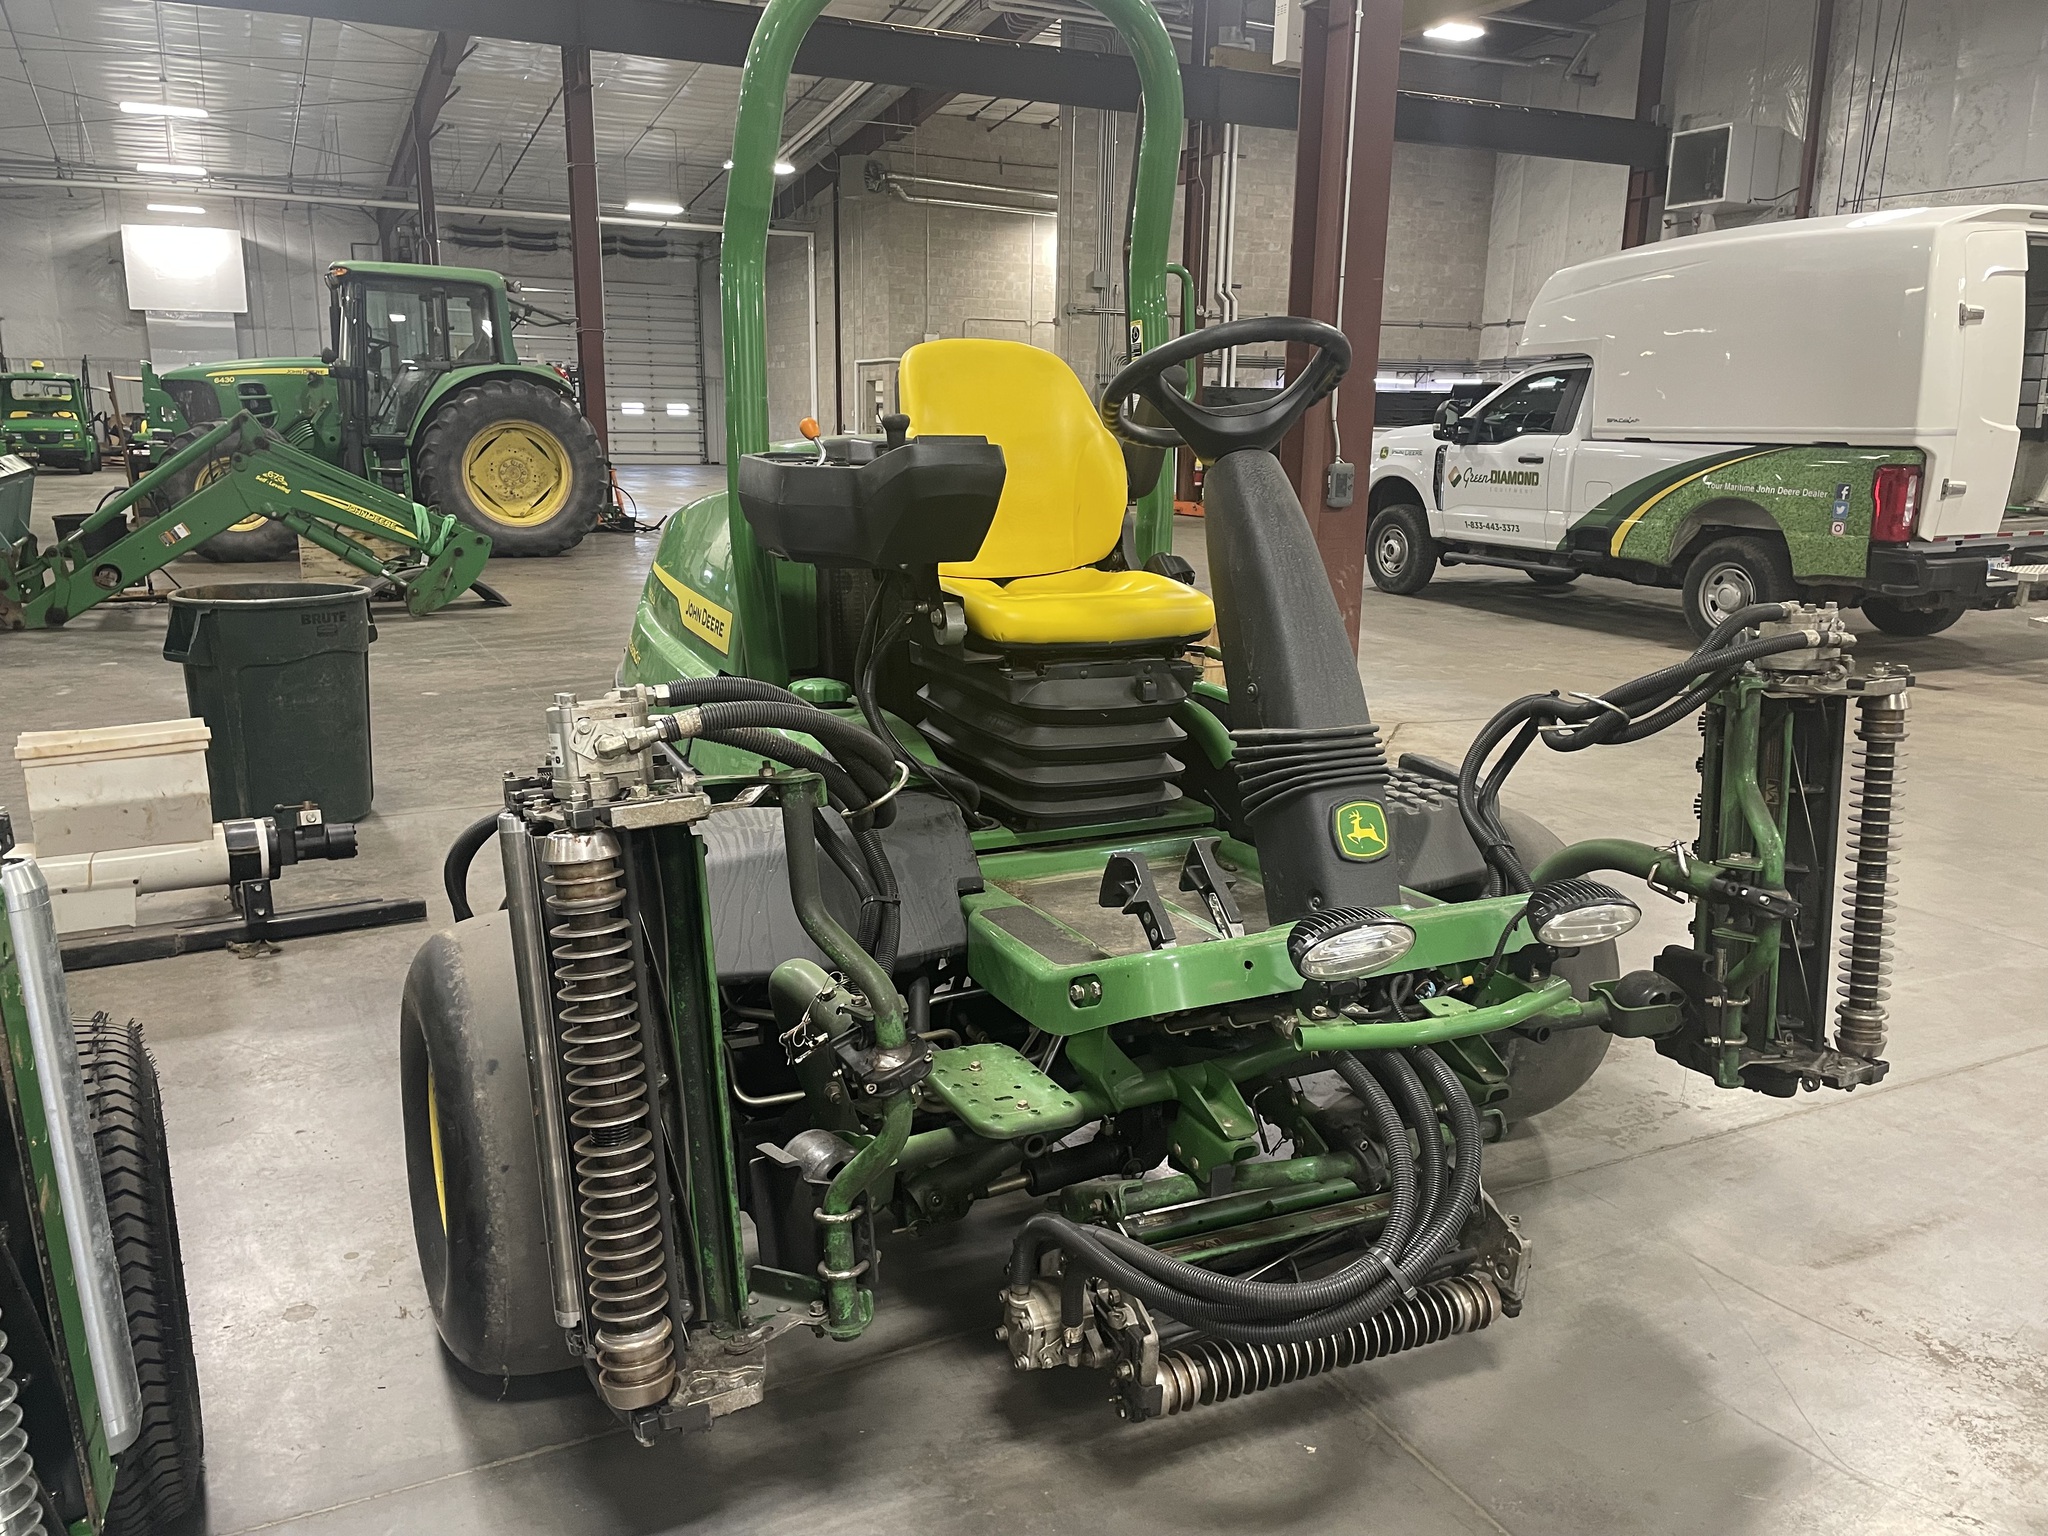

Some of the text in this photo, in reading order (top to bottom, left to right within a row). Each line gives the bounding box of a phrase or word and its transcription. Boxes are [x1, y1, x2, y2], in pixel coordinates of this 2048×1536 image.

[213, 376, 236, 384] 6430
[267, 470, 285, 482] 673
[1724, 482, 1755, 493] Maritime
[1755, 484, 1776, 494] John
[1777, 486, 1801, 496] Deere
[1802, 488, 1829, 498] Dealer
[1464, 521, 1520, 533] 1-833-443-3373
[301, 611, 347, 625] BRUTE
[685, 599, 725, 638] JOHN DEERE
